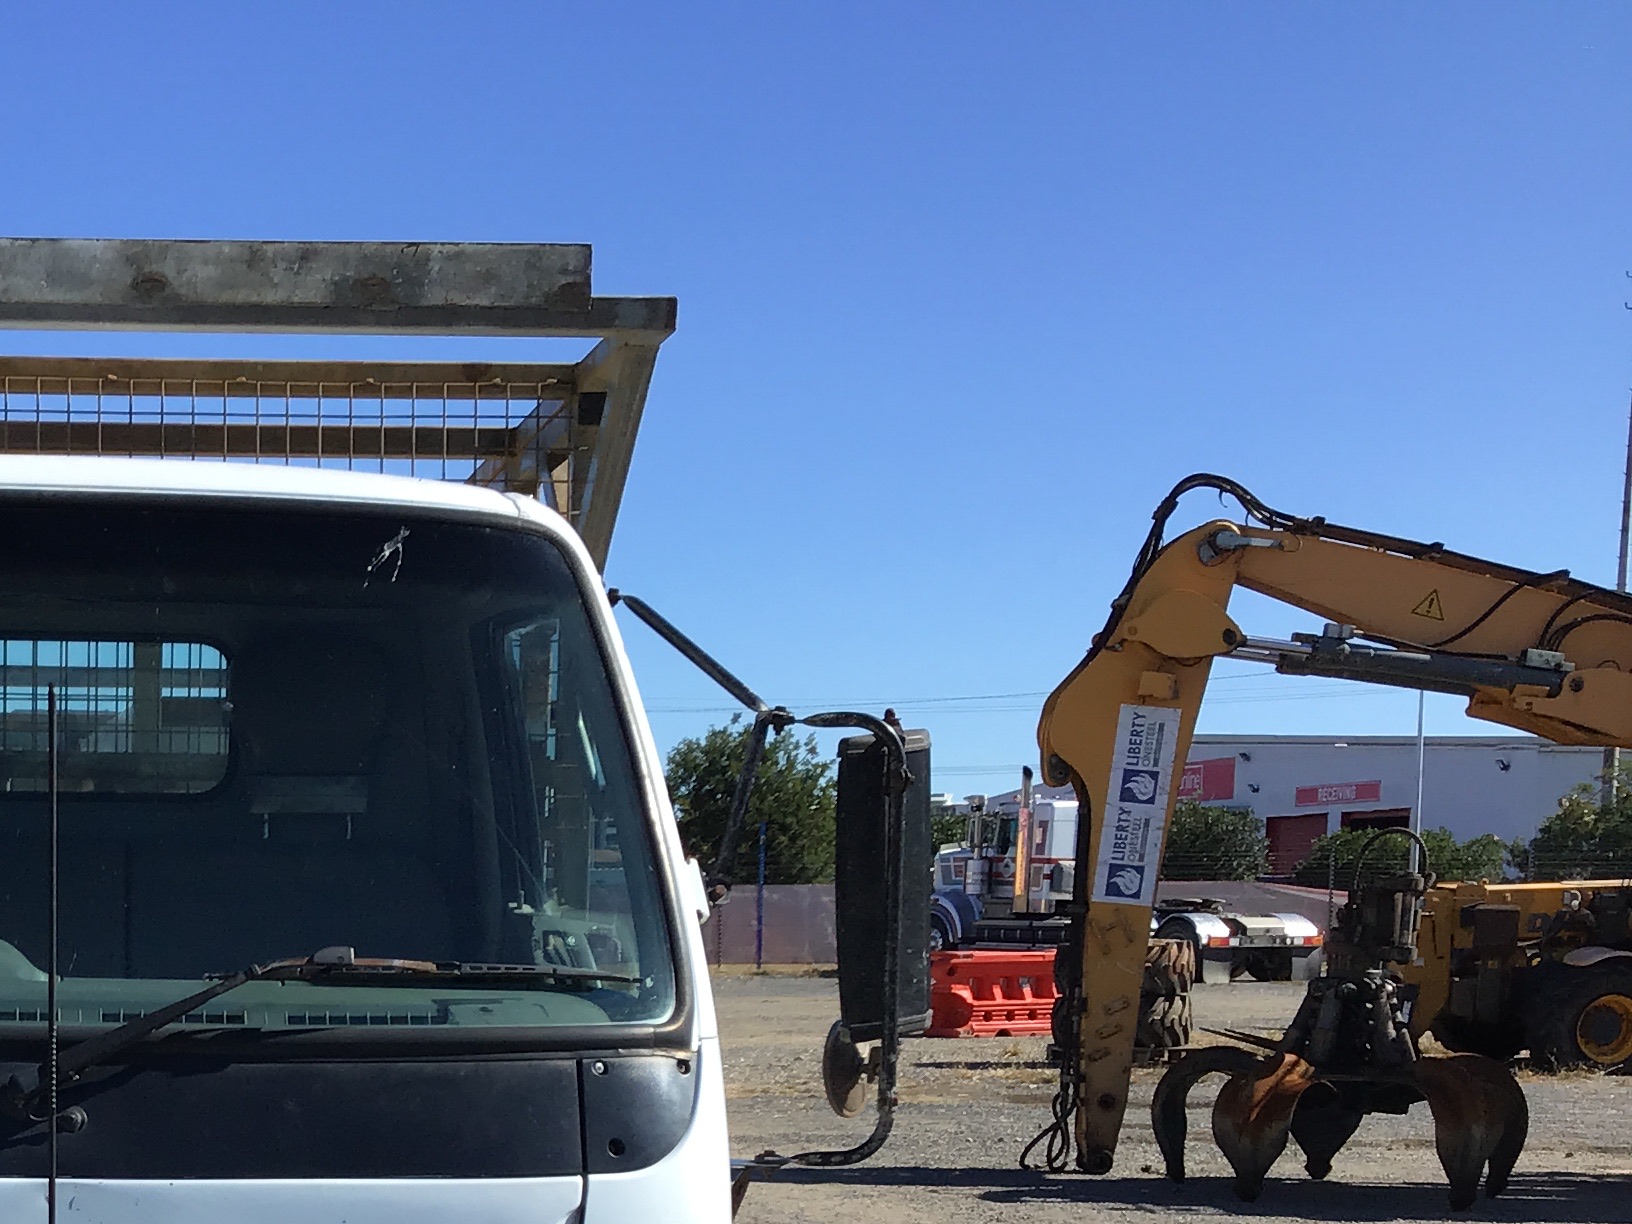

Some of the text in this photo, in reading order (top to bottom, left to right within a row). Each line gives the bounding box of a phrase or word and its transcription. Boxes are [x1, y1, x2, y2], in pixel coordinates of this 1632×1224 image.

[1125, 710, 1147, 767] LIBERTY
[1141, 721, 1158, 767] ONESTEEL
[1111, 806, 1132, 861] LIBERTY
